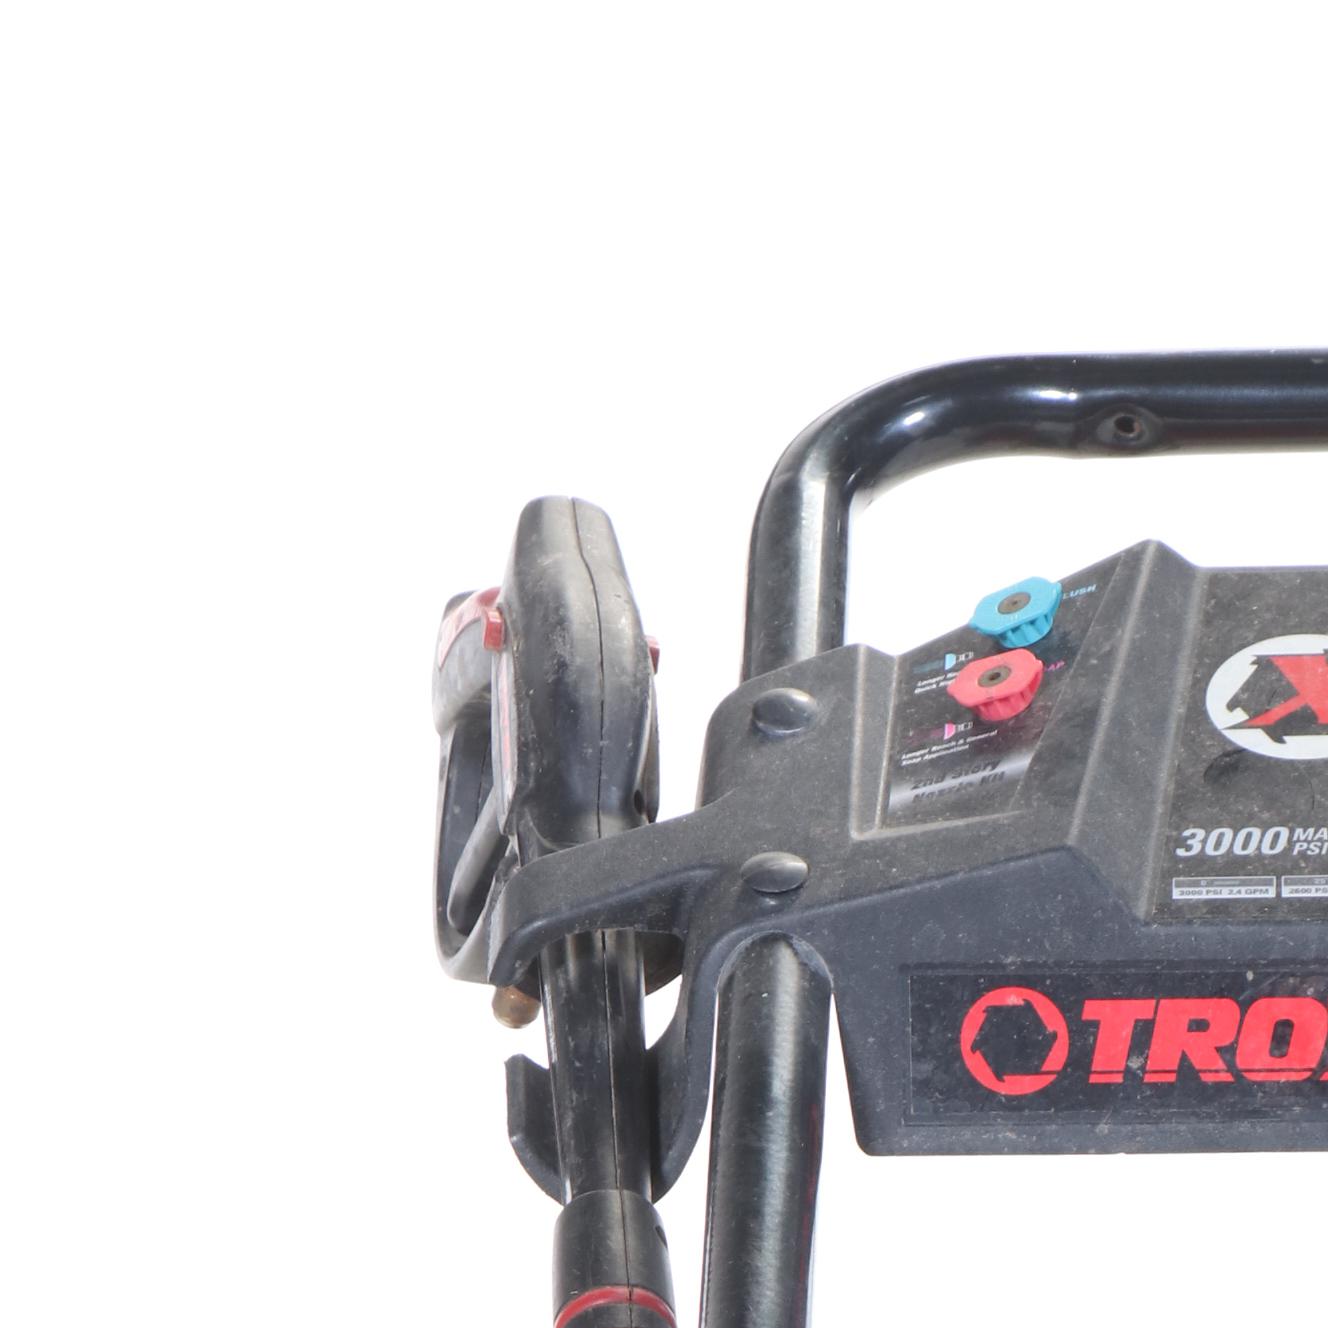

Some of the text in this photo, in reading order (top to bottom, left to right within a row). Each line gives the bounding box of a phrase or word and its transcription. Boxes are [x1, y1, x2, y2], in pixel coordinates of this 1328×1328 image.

[1062, 584, 1097, 600] LUSH
[1175, 826, 1290, 857] 3000
[1178, 888, 1270, 897] 3000 PSI 2.4 GPM
